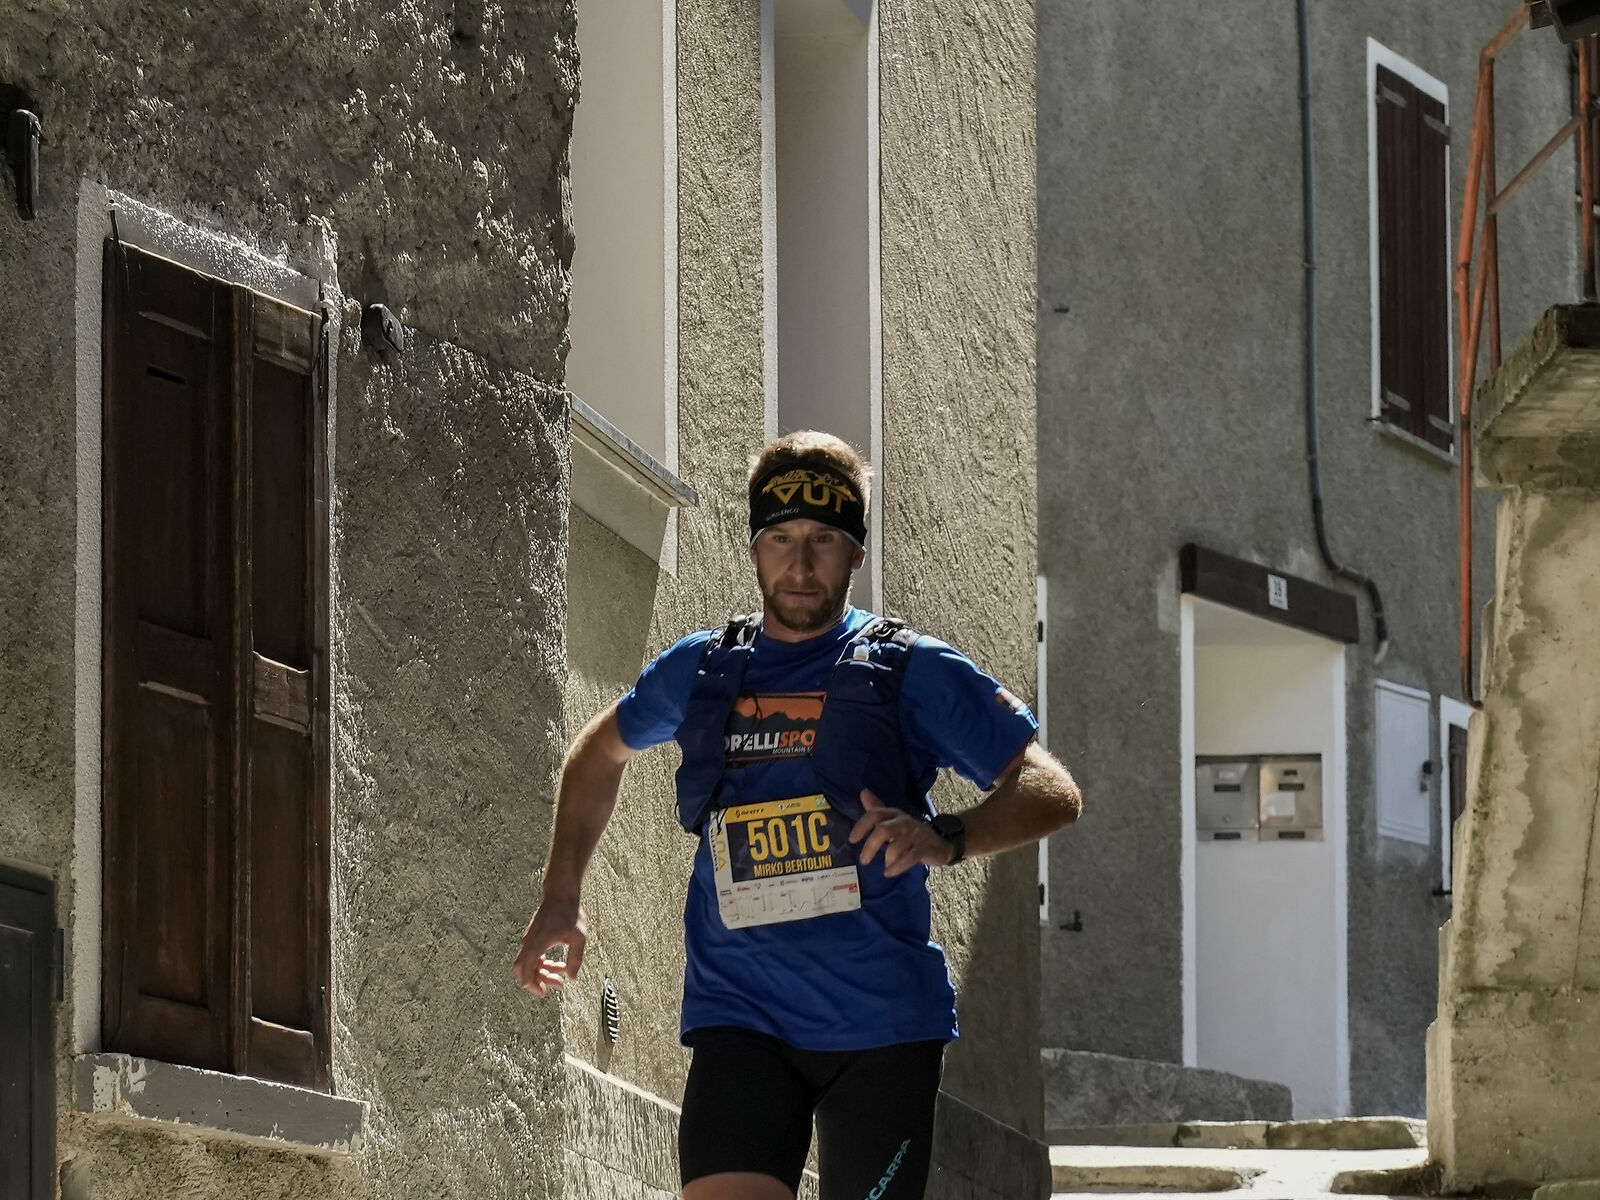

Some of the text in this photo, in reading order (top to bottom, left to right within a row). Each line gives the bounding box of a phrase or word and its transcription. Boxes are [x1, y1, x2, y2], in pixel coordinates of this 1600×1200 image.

[747, 811, 830, 861] 501C
[753, 854, 832, 878] MIRKO BERTOLINI
